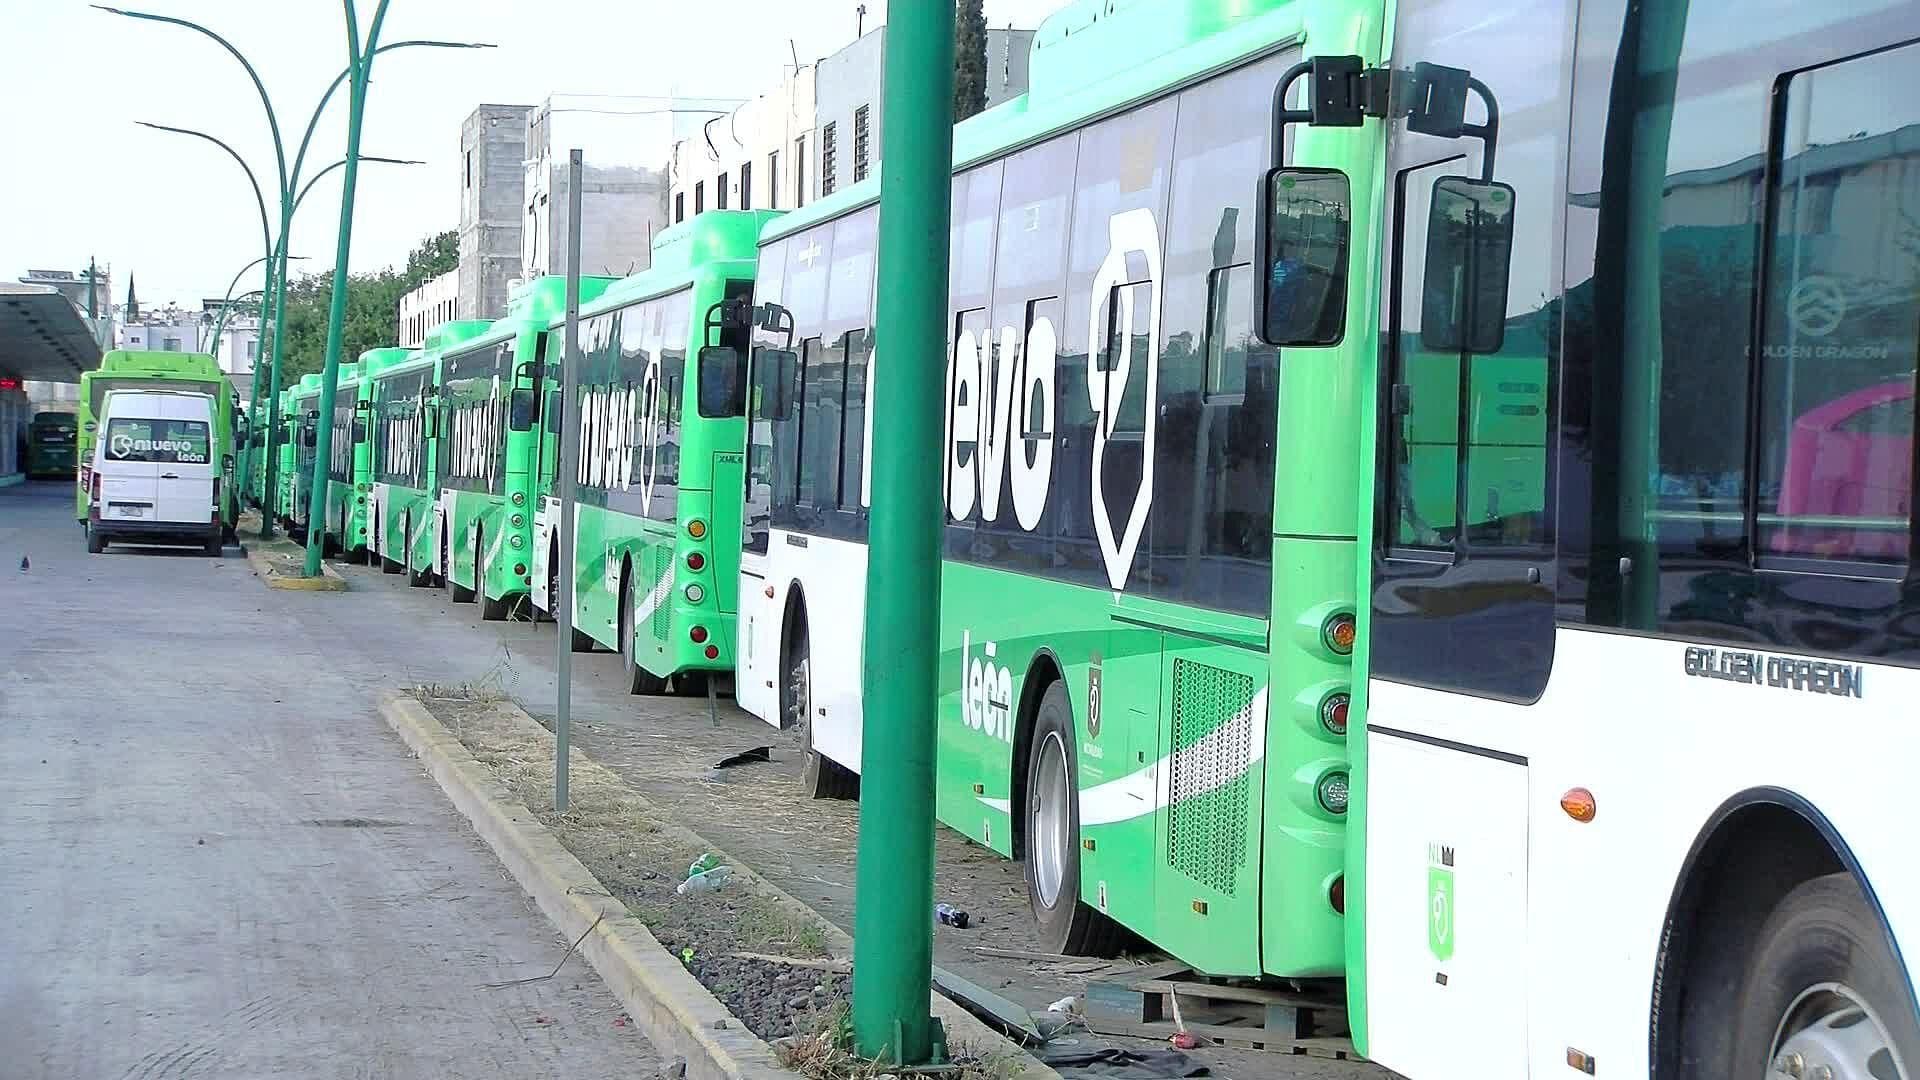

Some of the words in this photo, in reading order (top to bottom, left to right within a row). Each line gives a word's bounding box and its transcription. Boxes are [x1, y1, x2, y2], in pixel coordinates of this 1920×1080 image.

[1815, 345, 1888, 359] DRAGON
[134, 440, 192, 452] muevo
[177, 452, 204, 462] león
[1685, 646, 1763, 685] GOLDEN
[1767, 656, 1863, 699] DRAGON
[961, 628, 1012, 744] león
